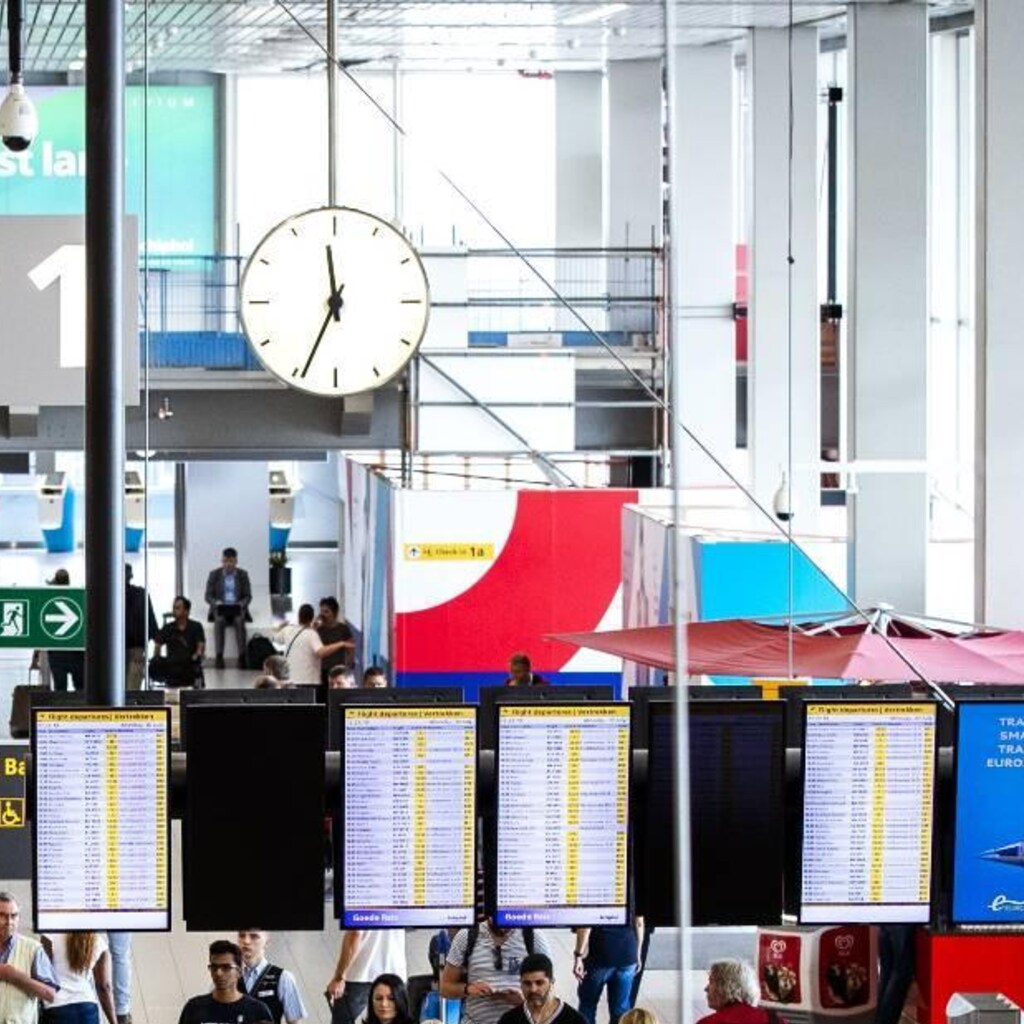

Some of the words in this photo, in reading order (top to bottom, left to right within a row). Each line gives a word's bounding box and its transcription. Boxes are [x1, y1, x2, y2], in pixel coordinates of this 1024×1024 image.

[28, 244, 87, 368] 1
[470, 546, 485, 557] 1a
[986, 757, 1024, 768] EURO
